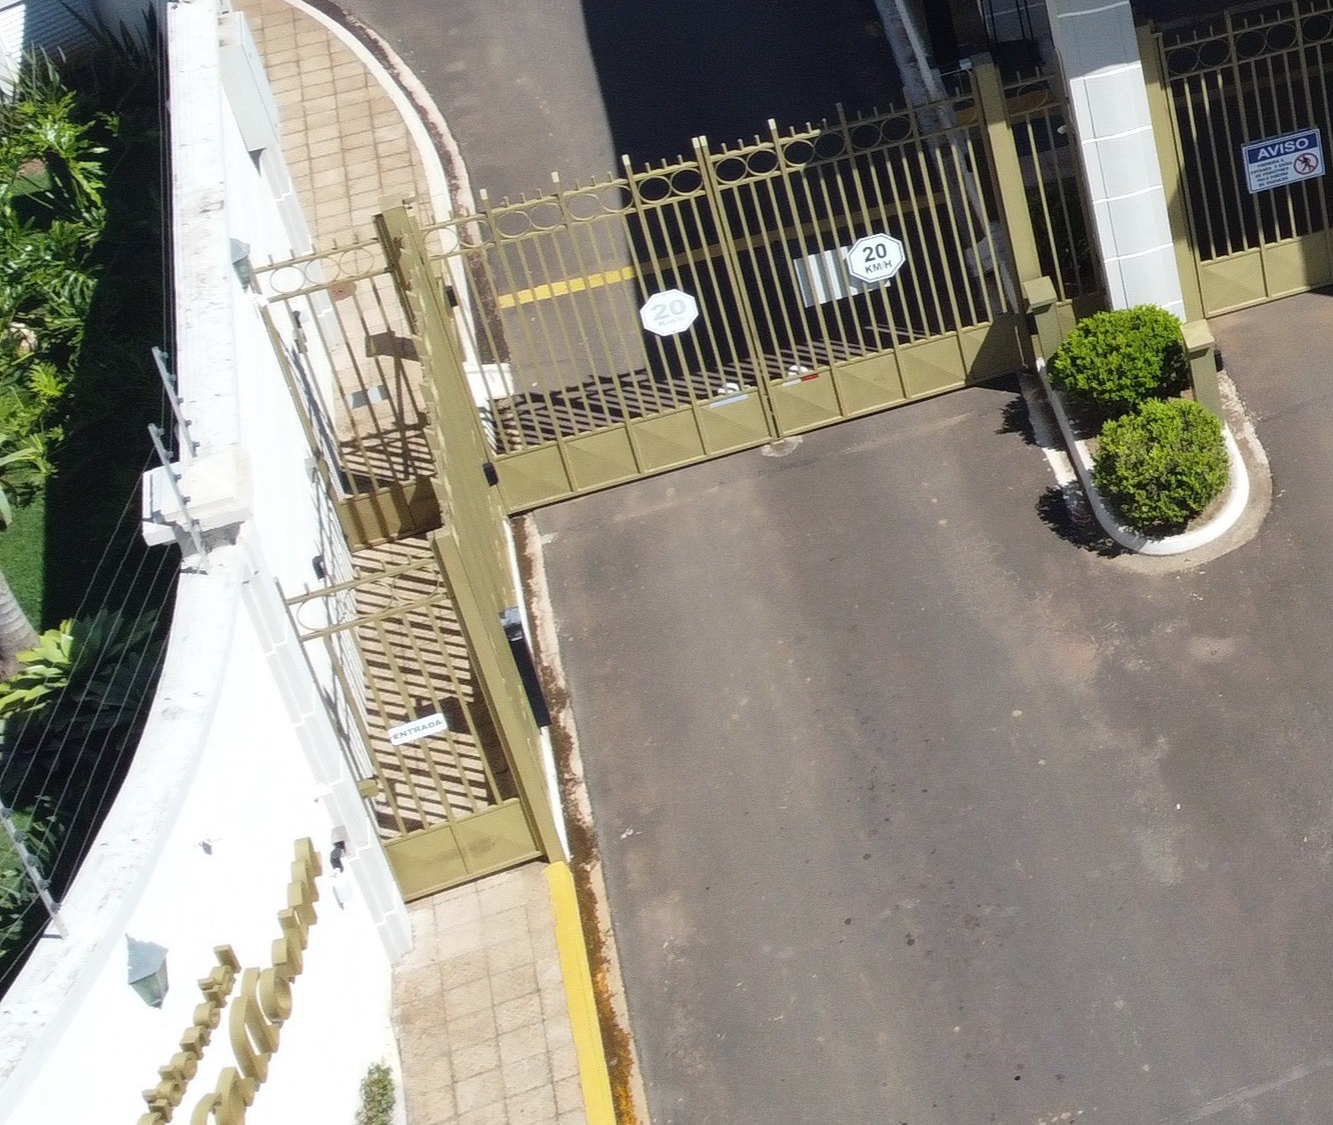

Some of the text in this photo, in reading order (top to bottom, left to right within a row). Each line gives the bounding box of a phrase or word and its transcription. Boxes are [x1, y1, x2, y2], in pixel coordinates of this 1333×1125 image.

[1257, 137, 1309, 160] AVISO
[862, 242, 888, 263] 20
[864, 259, 892, 274] KM/H
[651, 298, 687, 322] 20
[392, 719, 442, 740] ENTRADA
